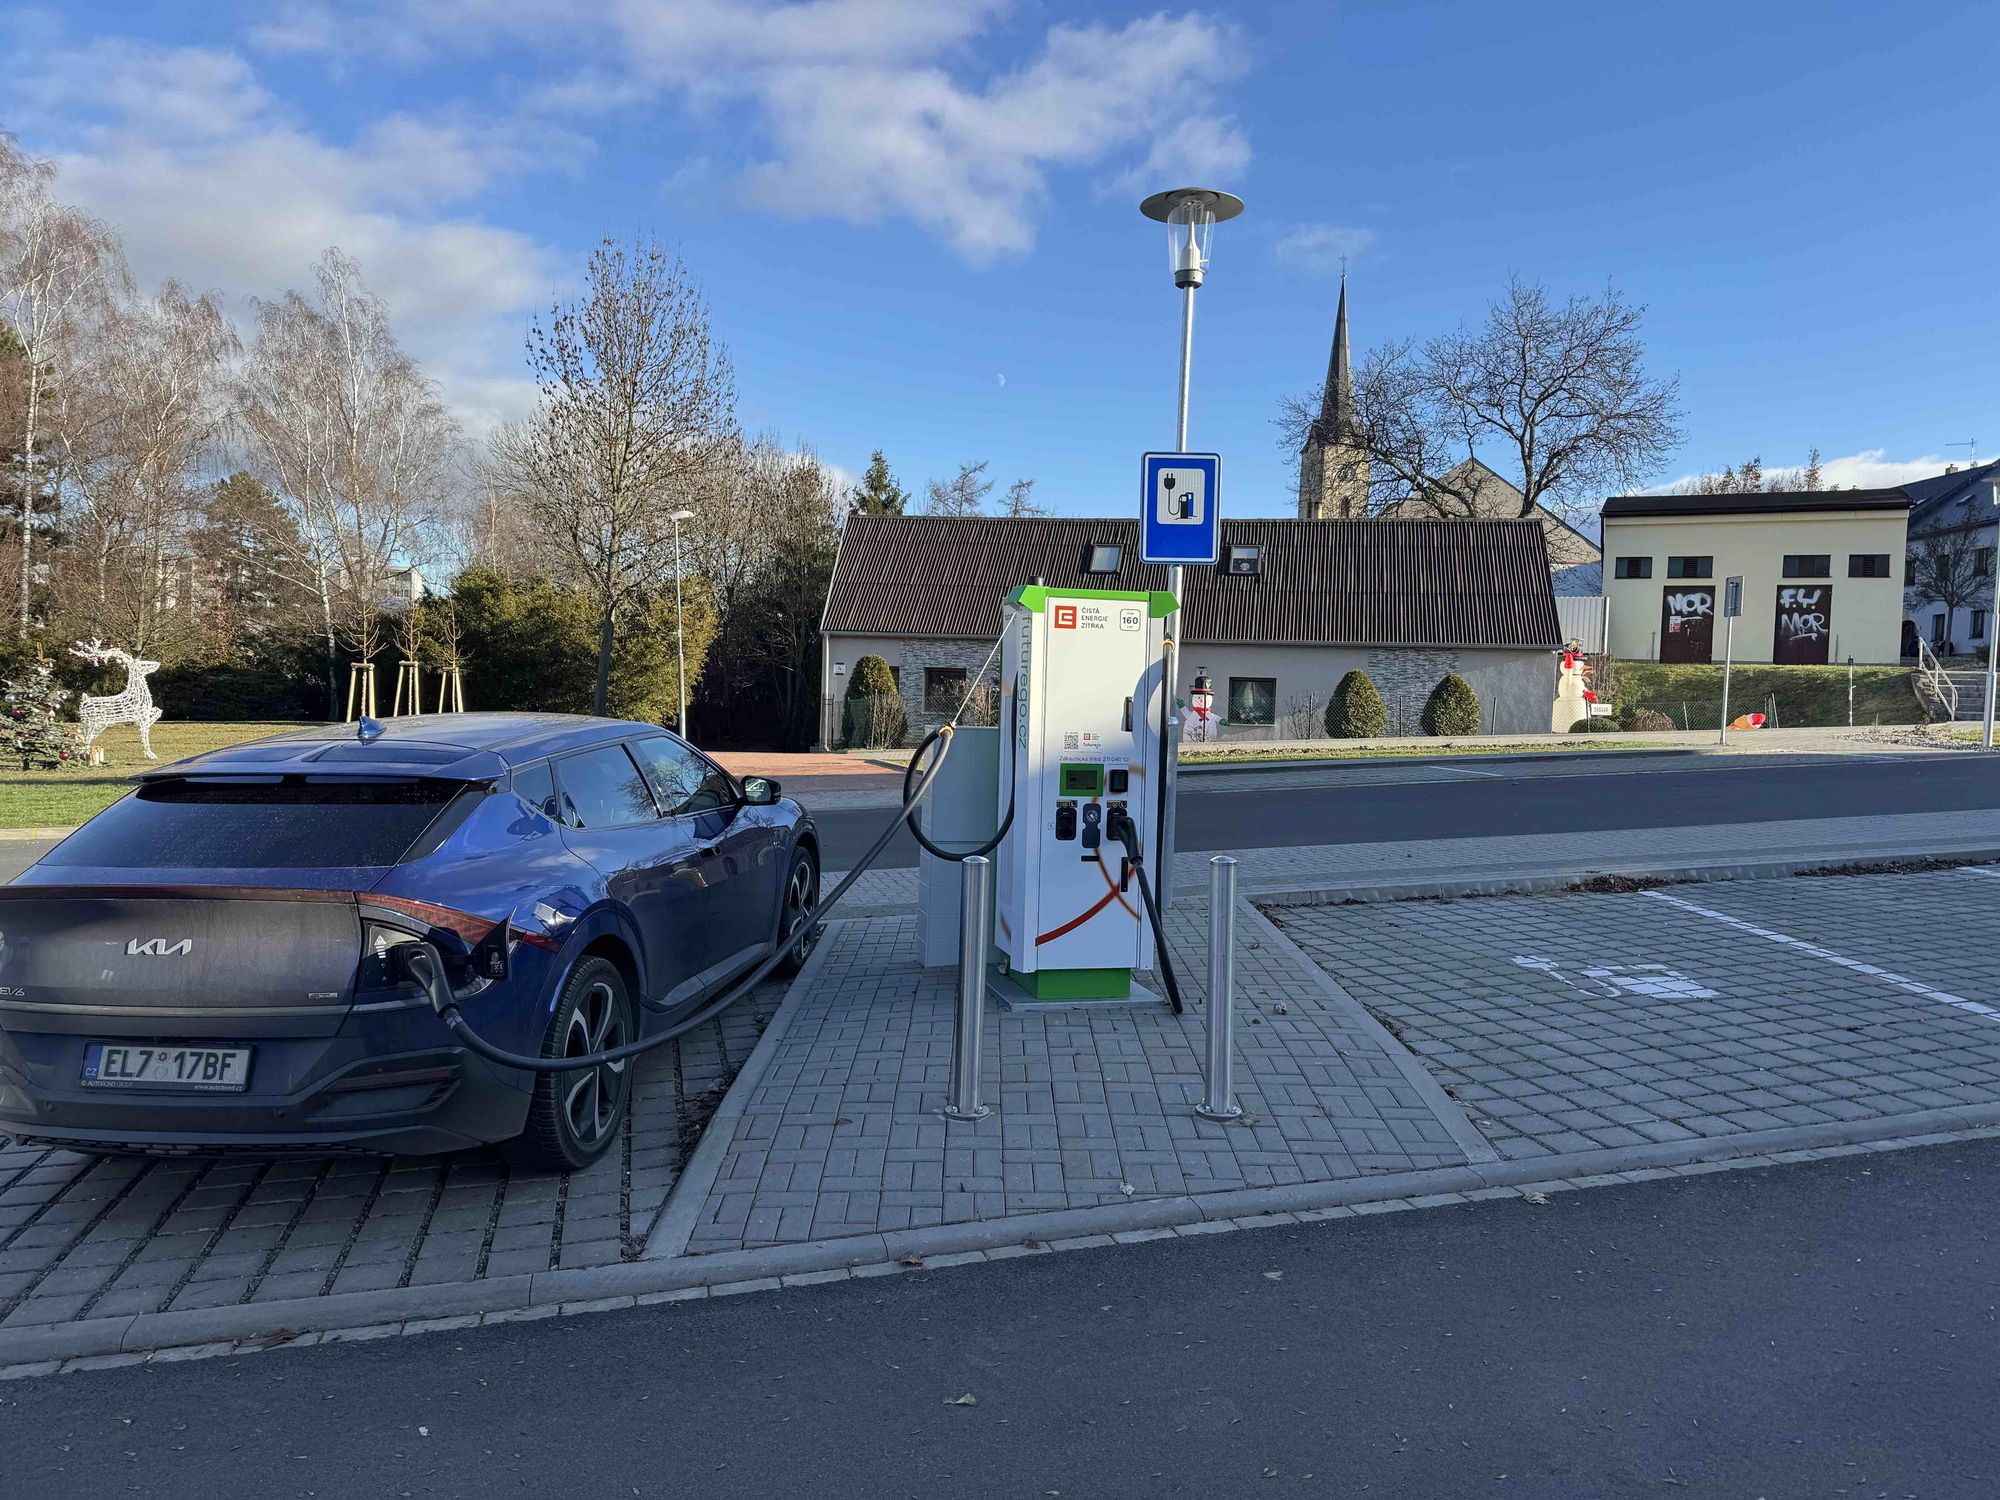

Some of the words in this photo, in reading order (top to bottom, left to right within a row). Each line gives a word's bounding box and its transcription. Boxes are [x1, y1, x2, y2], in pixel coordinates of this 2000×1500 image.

[1081, 606, 1100, 614] ČISTÁ
[1122, 616, 1139, 625] 160
[1781, 612, 1828, 635] MOR
[1017, 614, 1032, 749] futurego.cz
[125, 938, 192, 955] KIA
[0, 987, 25, 996] EV6
[104, 1049, 153, 1077] EL7
[174, 1051, 236, 1080] 17BF
[85, 1067, 97, 1076] CZ
